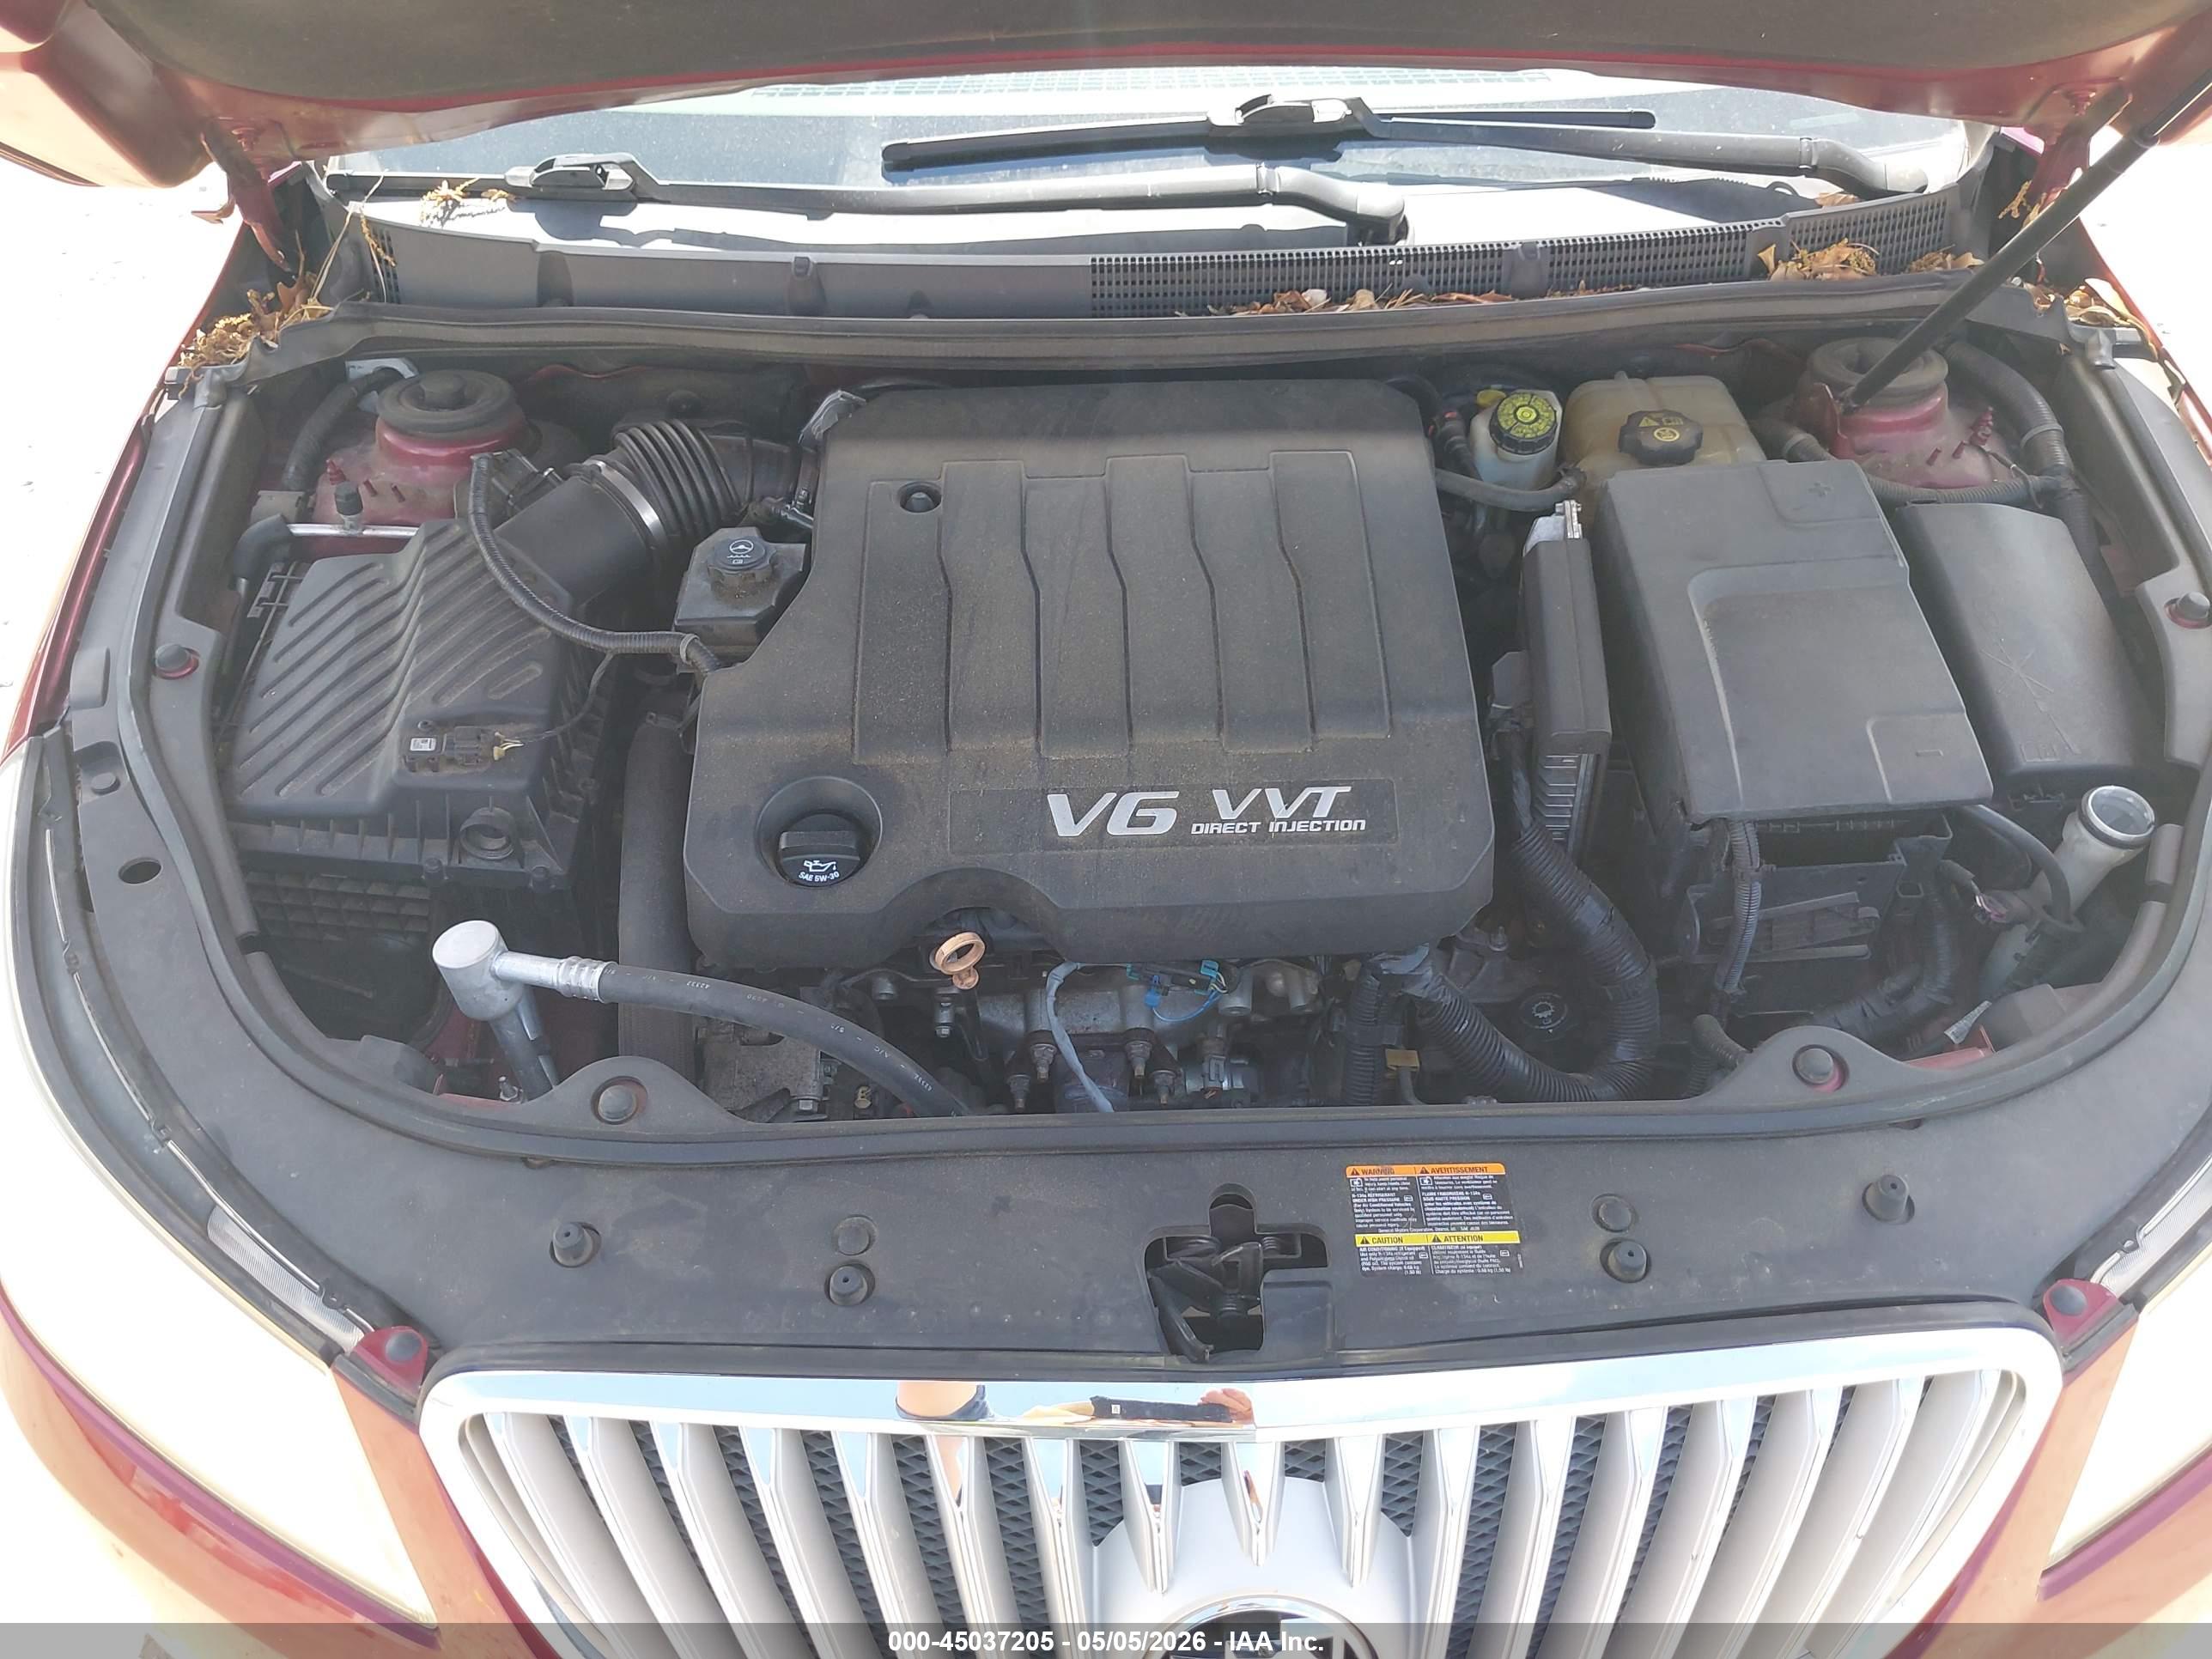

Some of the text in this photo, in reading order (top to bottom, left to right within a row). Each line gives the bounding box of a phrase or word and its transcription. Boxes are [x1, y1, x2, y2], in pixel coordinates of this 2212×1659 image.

[1047, 791, 1180, 837] V6
[1212, 786, 1352, 820] VVT
[1191, 819, 1366, 835] DIRECT INJECTION
[799, 871, 840, 882] SAE 5W-30
